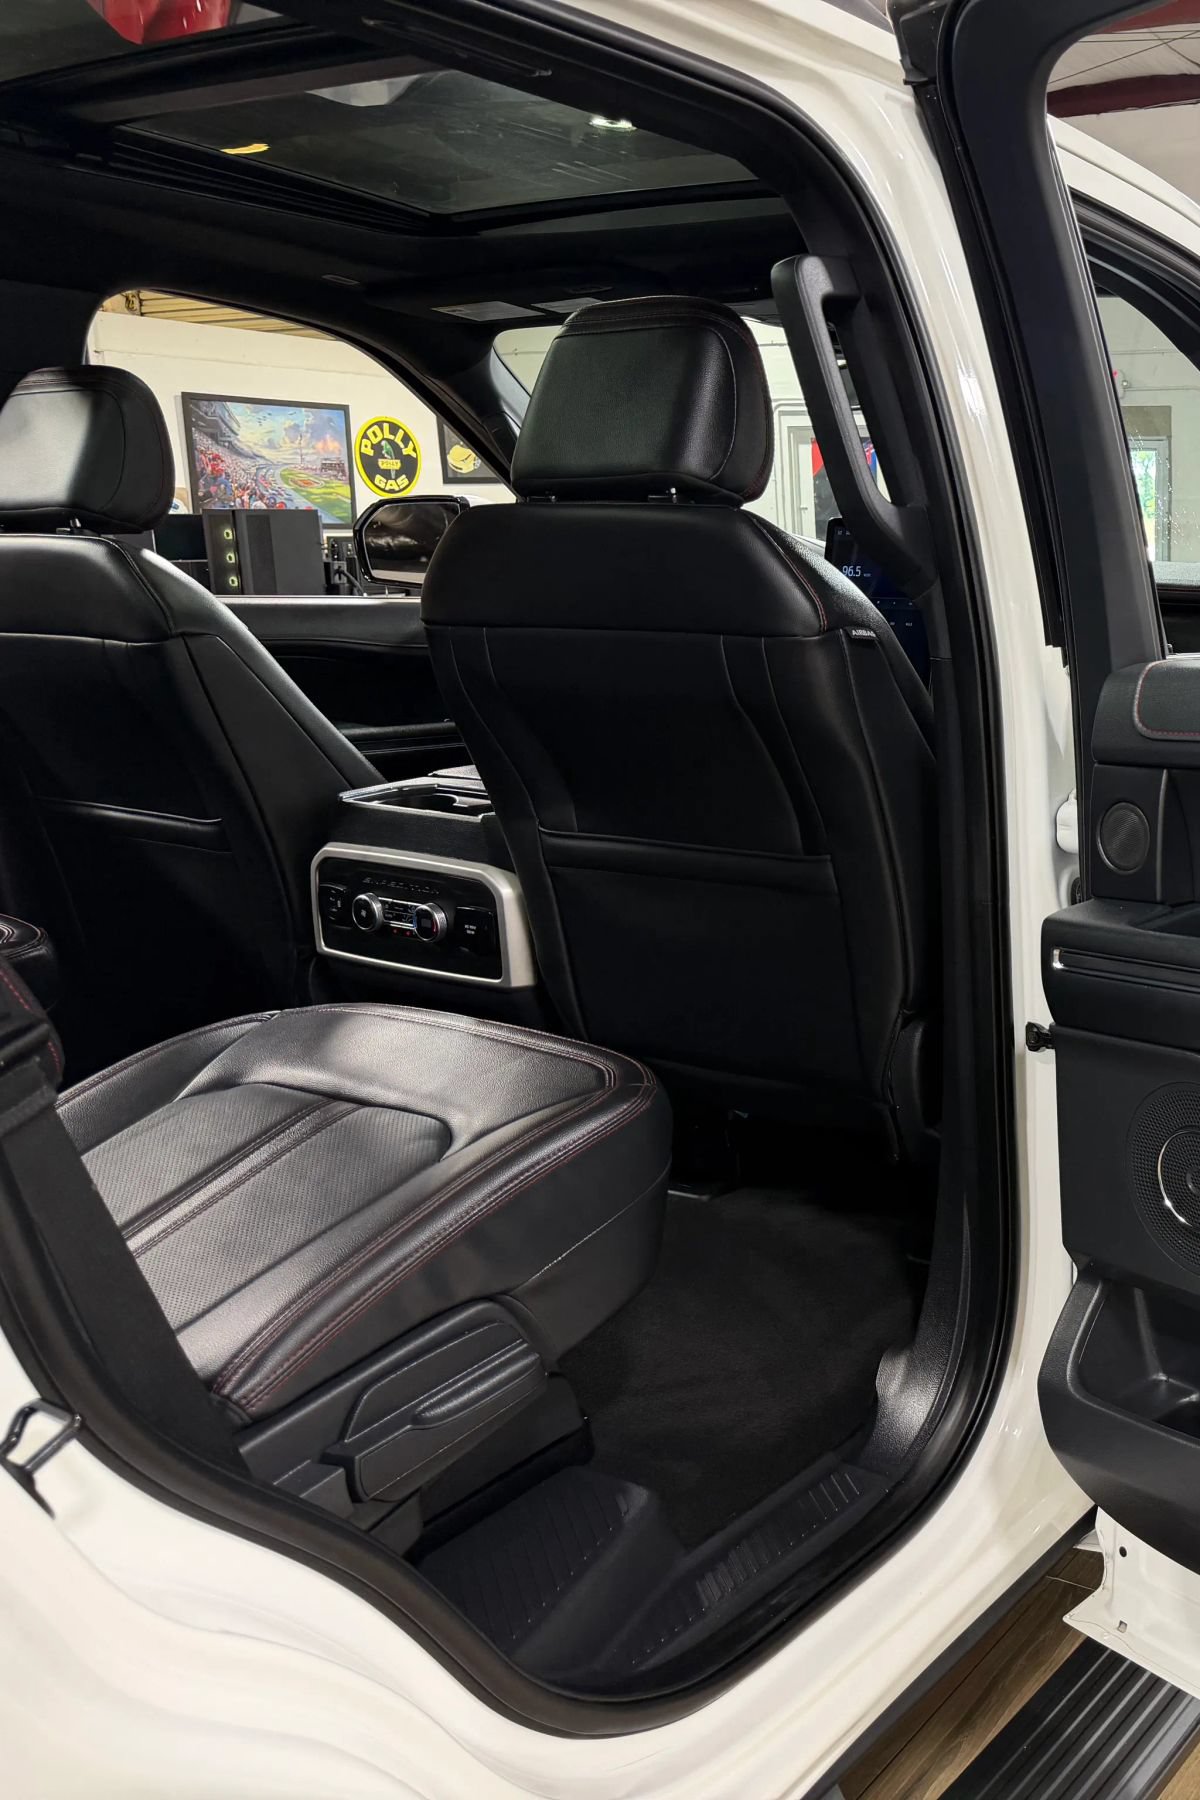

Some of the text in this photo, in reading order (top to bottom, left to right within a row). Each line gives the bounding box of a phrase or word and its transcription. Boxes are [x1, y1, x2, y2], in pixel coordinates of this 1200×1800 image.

[361, 423, 417, 458] POLLY
[374, 474, 409, 491] GAS
[842, 565, 861, 577] 96.5
